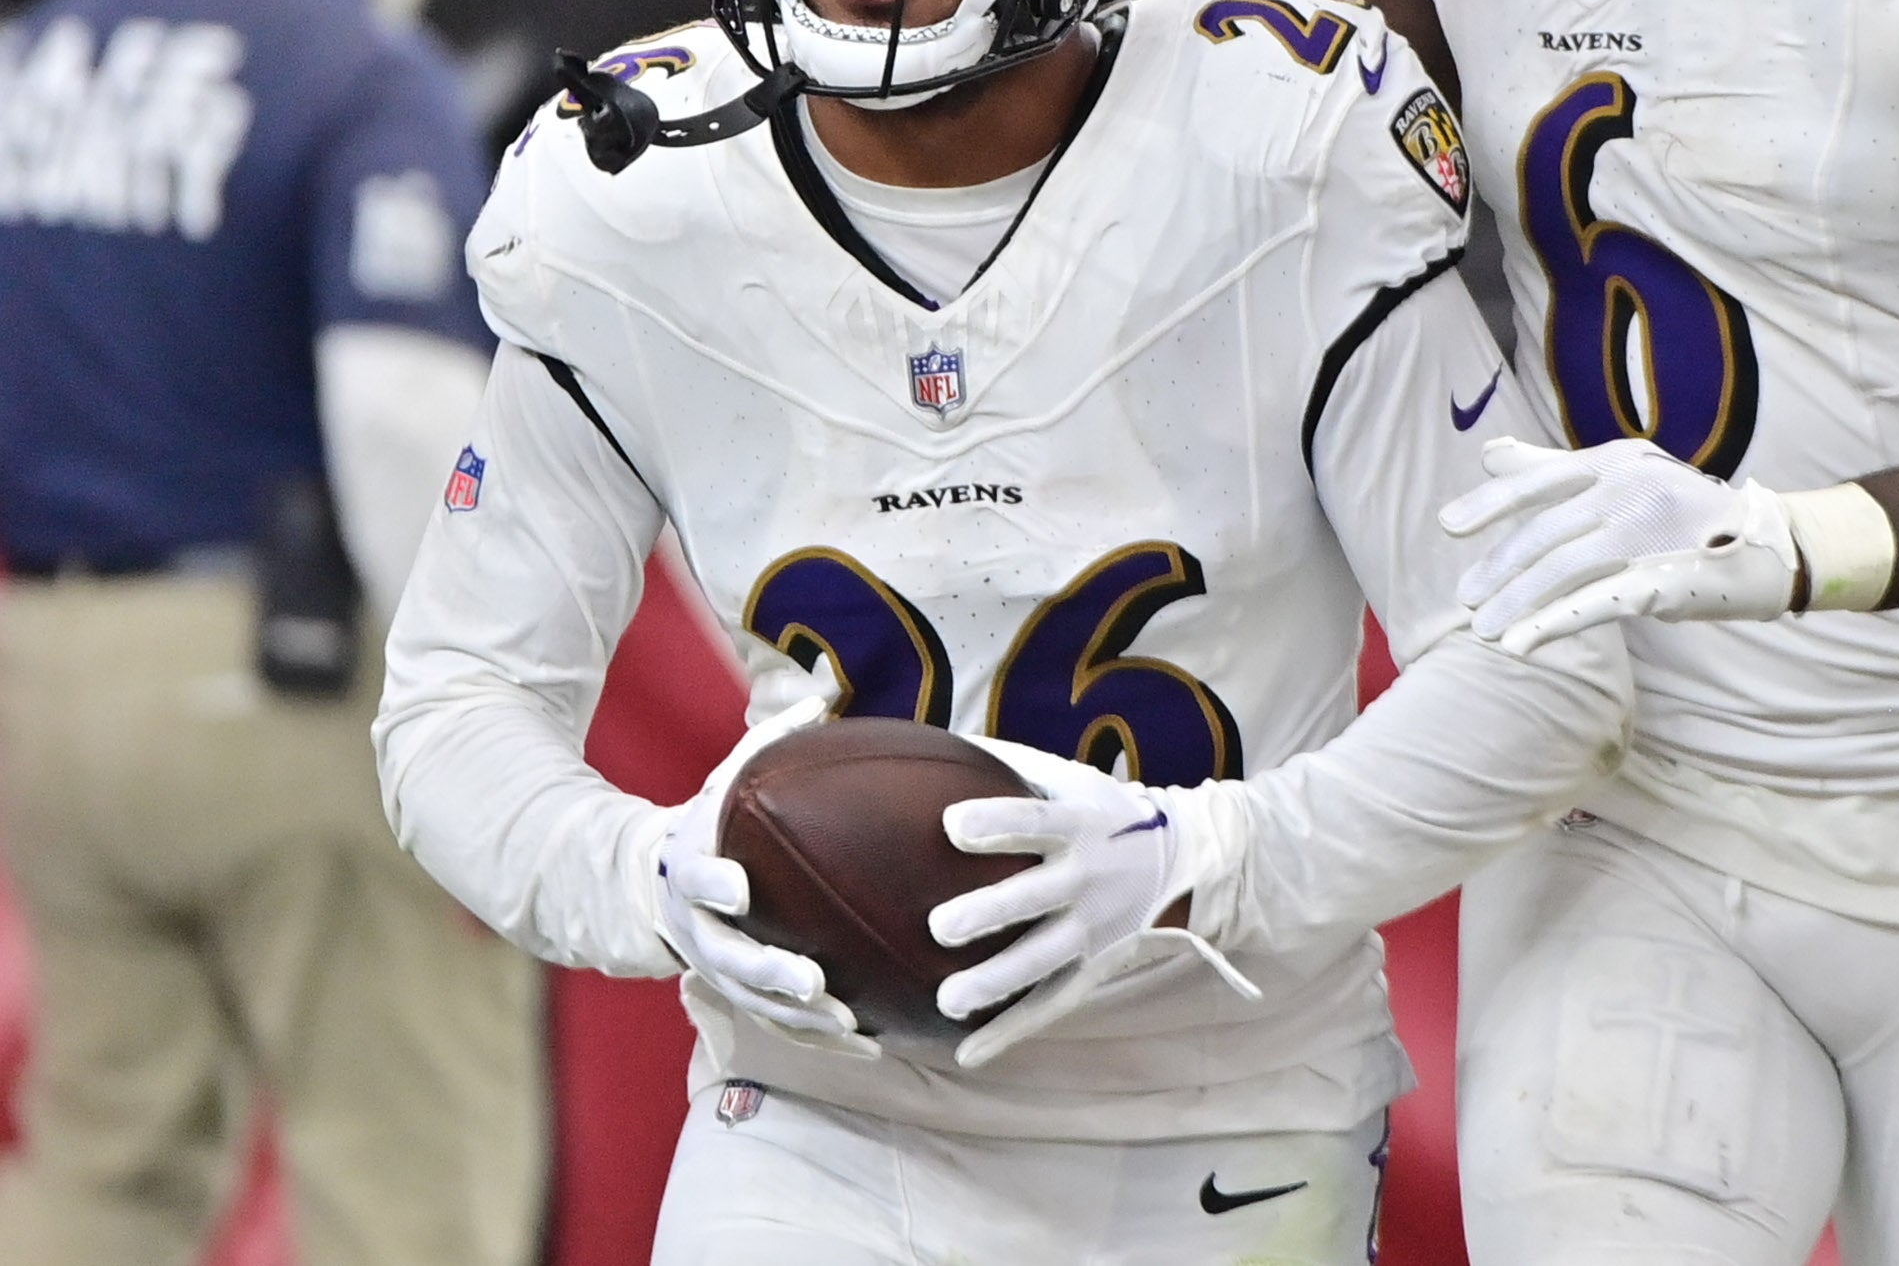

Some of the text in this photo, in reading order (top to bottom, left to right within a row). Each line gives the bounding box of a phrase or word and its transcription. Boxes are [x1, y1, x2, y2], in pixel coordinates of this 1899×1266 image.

[1537, 31, 1643, 53] RAVENS
[1516, 69, 1760, 484] 6
[918, 373, 957, 406] NFL
[871, 482, 1024, 514] RAVENS
